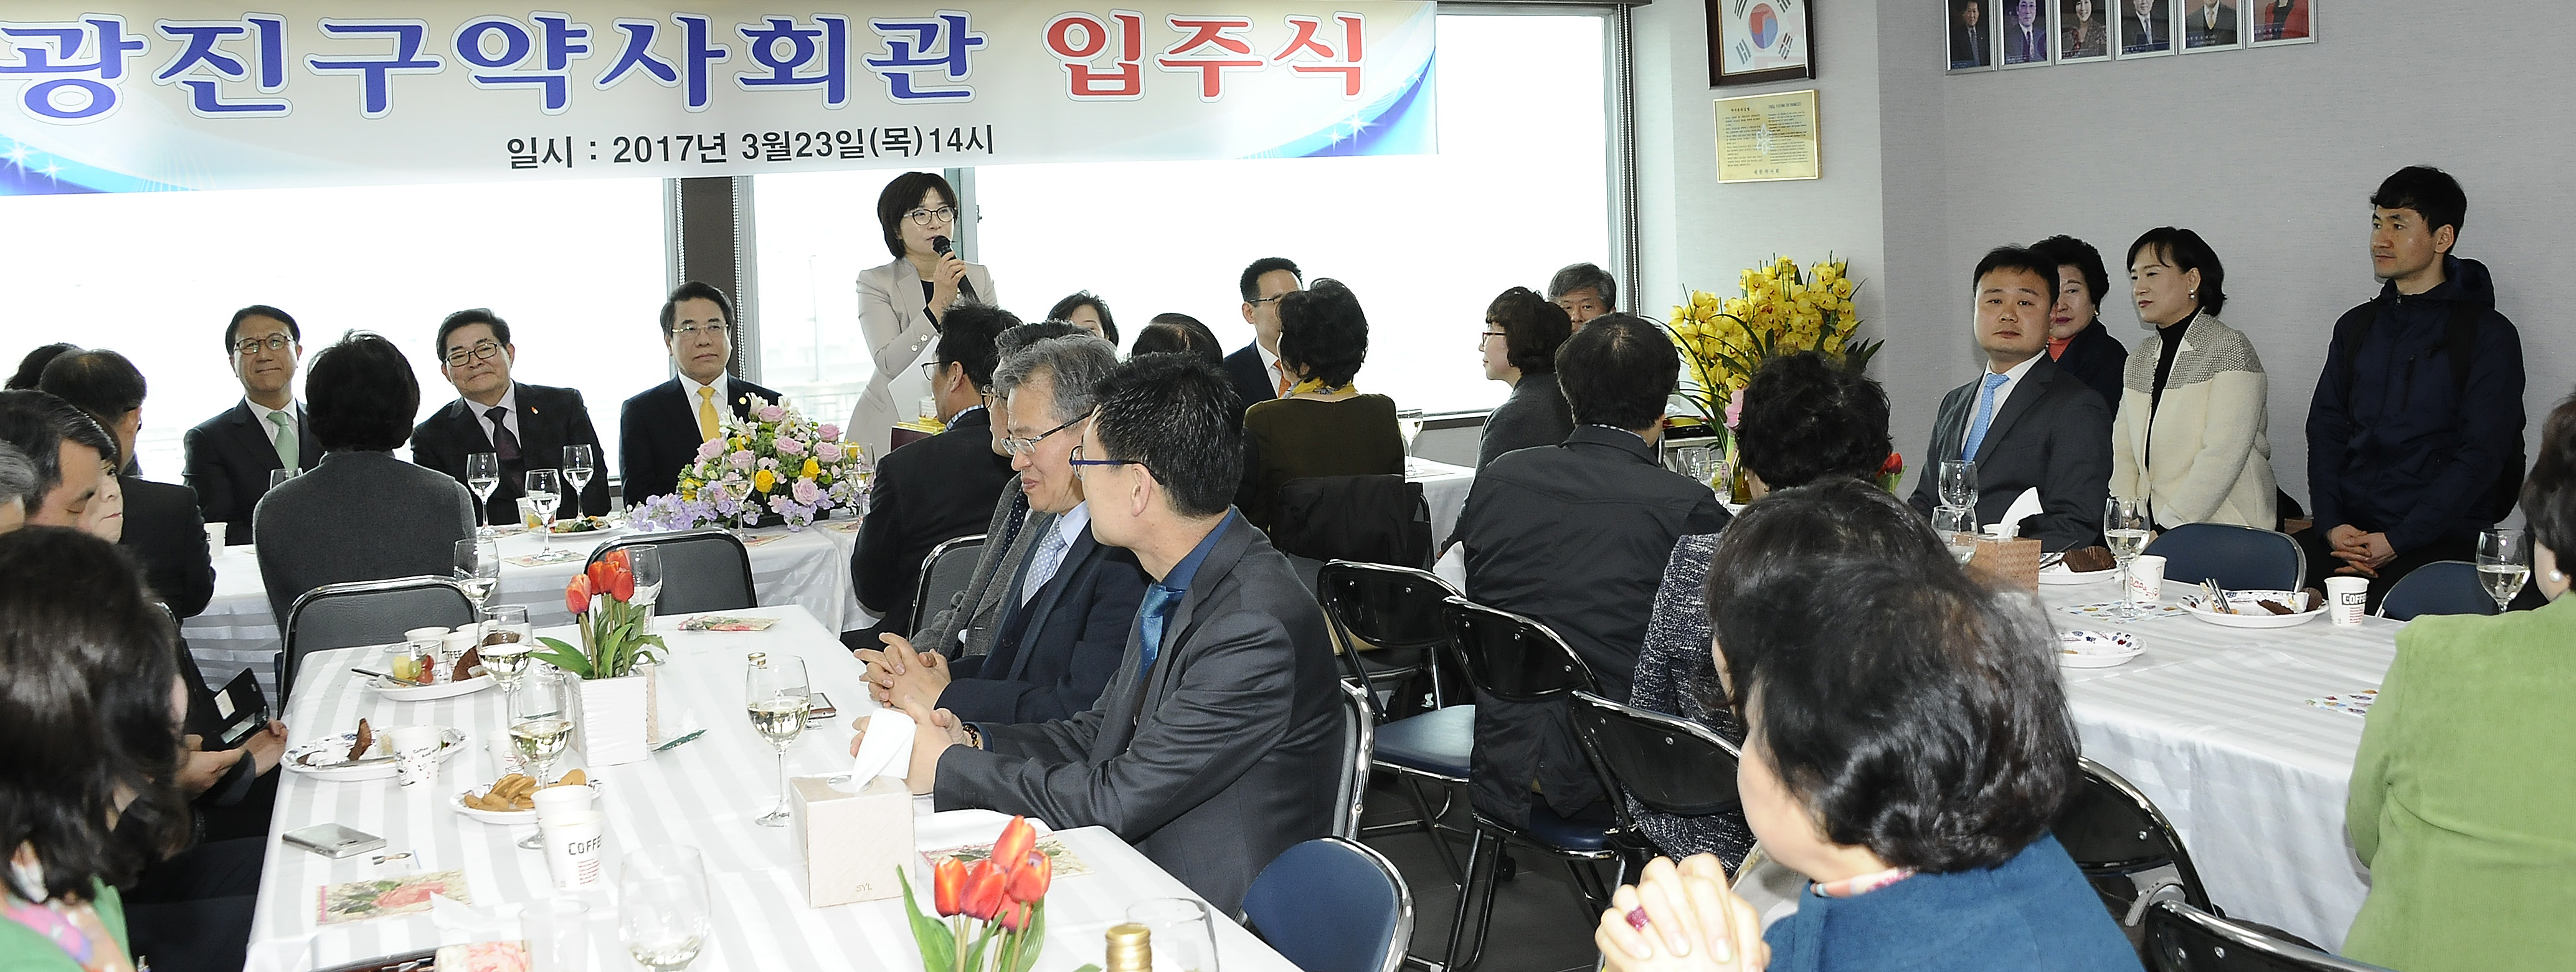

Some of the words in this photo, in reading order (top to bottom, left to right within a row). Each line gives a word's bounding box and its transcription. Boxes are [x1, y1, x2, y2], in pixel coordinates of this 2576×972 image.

[0, 14, 984, 119] 광진구약사회관
[1046, 14, 1363, 97] 입주식
[506, 136, 573, 169] 일시
[612, 132, 727, 164] 2017년
